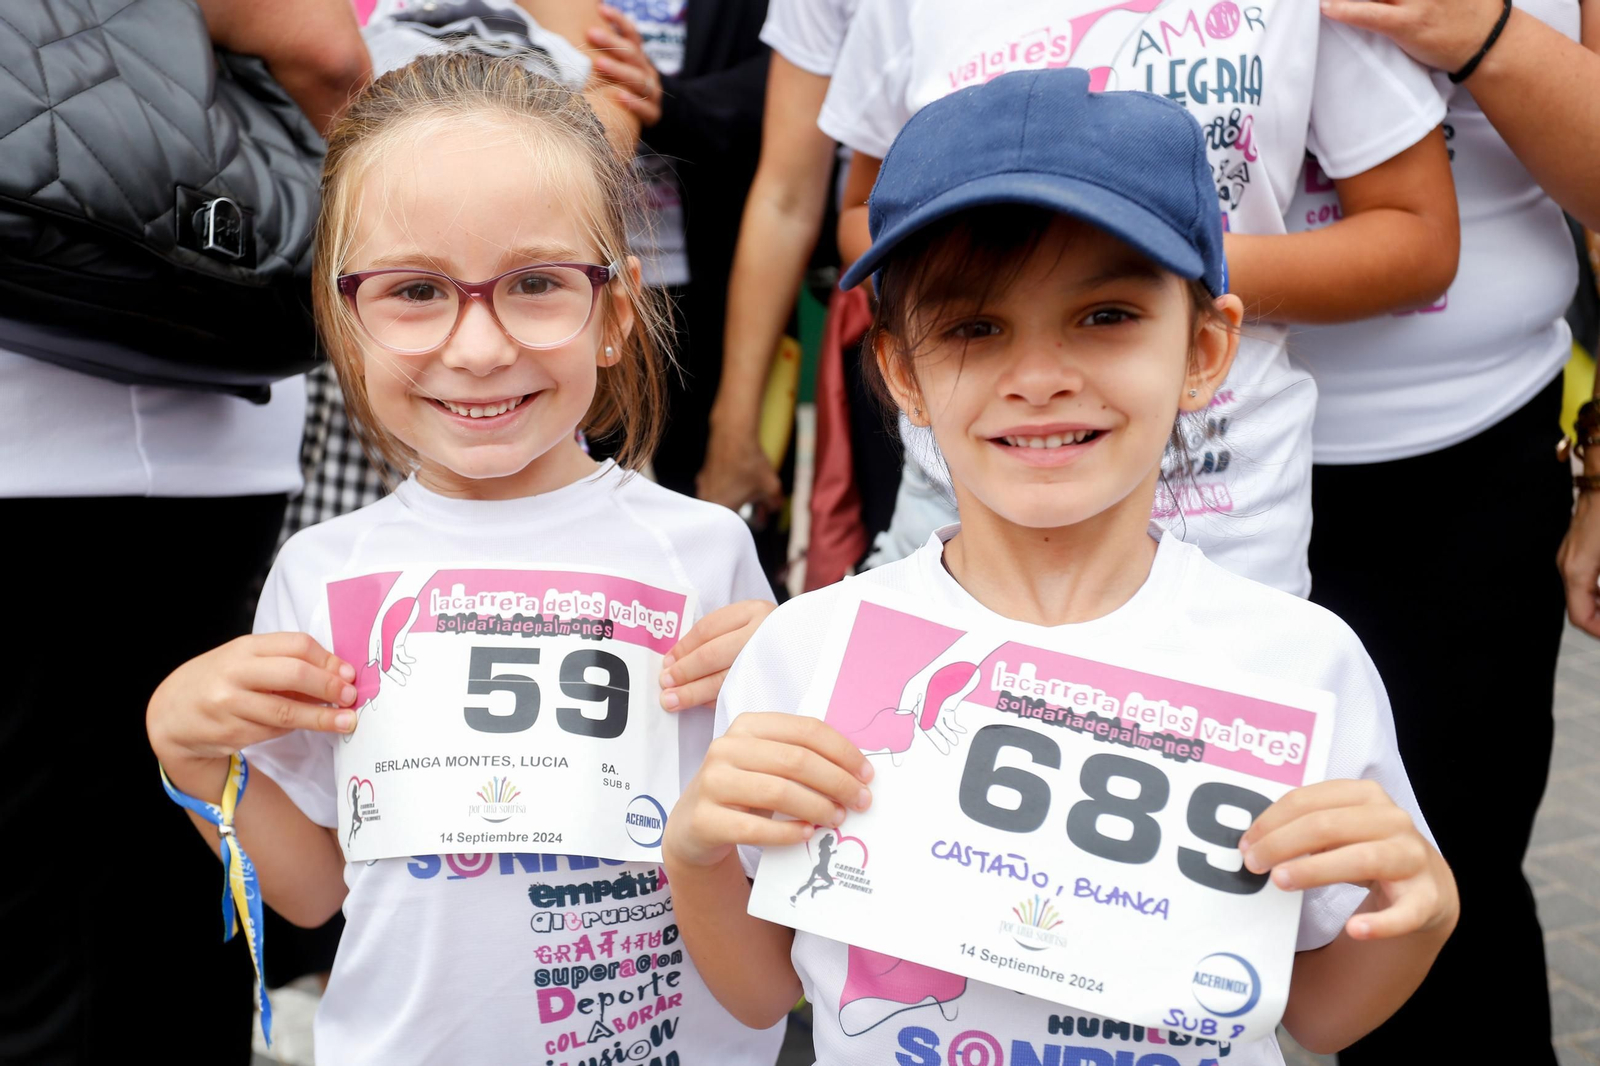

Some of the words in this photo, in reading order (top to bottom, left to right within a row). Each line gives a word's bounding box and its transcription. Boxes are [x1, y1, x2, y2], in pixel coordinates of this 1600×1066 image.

[949, 33, 1067, 88] valores
[610, 602, 676, 636] valores
[463, 646, 630, 739] 59
[1203, 720, 1303, 762] valores
[375, 757, 441, 773] BERLANGA
[446, 755, 515, 768] MONTES,
[520, 756, 569, 768] LUCIA
[601, 763, 619, 776] 8A.
[603, 778, 623, 789] SUB
[625, 782, 631, 791] 8
[625, 812, 661, 830] ACERINOX
[959, 725, 1274, 894] 689
[440, 832, 453, 843] 14
[457, 832, 528, 845] Septiembre
[533, 832, 563, 843] 2024
[834, 863, 866, 876] CARRERA
[839, 880, 874, 894] PALMONES
[1073, 877, 1170, 920] BLANCA
[960, 943, 976, 957] 14
[980, 948, 1065, 983] Septiembre
[1069, 973, 1105, 994] 2024
[536, 970, 681, 1024] Deporte
[1192, 971, 1249, 996] ACERINOX
[1163, 1008, 1218, 1036] SUB
